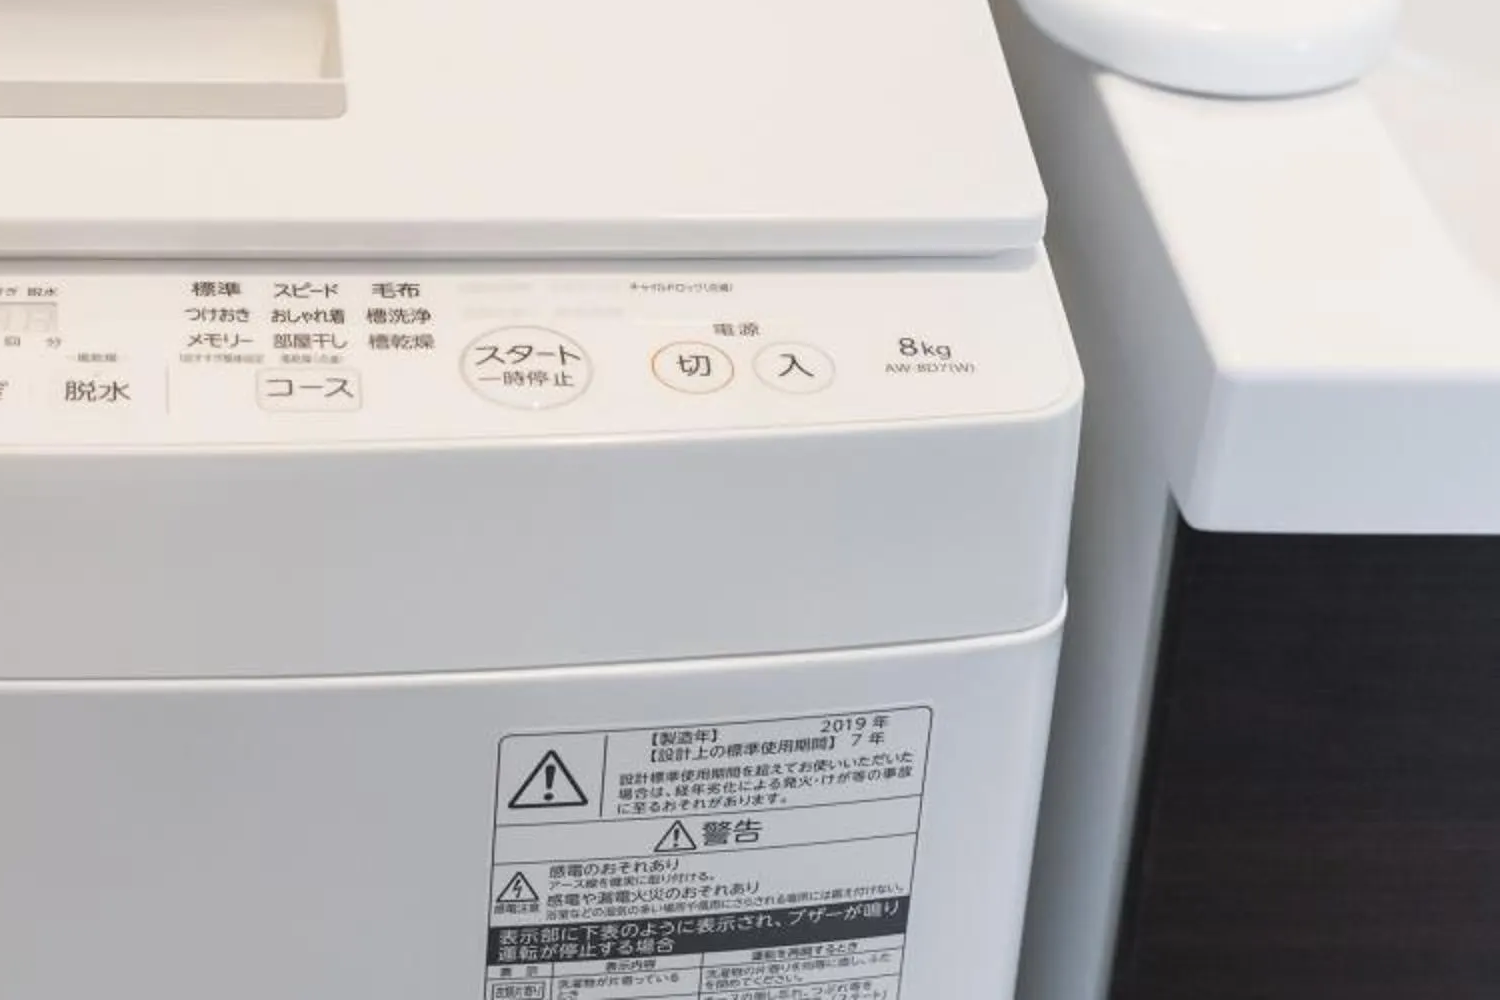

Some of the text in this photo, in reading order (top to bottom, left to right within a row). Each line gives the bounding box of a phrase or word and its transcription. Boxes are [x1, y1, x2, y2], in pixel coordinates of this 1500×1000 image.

[191, 282, 242, 298] 標準
[273, 282, 339, 299] スピード
[372, 282, 421, 299] 毛布
[184, 307, 251, 324] つけおき
[271, 307, 346, 325] おしゃれ着
[366, 307, 431, 325] 槽洗浄
[712, 322, 760, 337] 電源
[187, 332, 254, 349] メモリー
[273, 333, 348, 350] 部屋干し
[368, 333, 435, 351] 槽乾燥
[475, 343, 582, 367] スタート
[676, 353, 711, 377] 切
[778, 353, 815, 378] 入
[477, 370, 575, 388] 一時停止
[64, 379, 133, 402] 脱水
[266, 377, 355, 400] コース
[650, 728, 719, 746] 【製造年】
[649, 735, 836, 763] 【設計上の標準使用期間】
[702, 818, 763, 845] 警告
[549, 859, 680, 879] 感電のおそれあり
